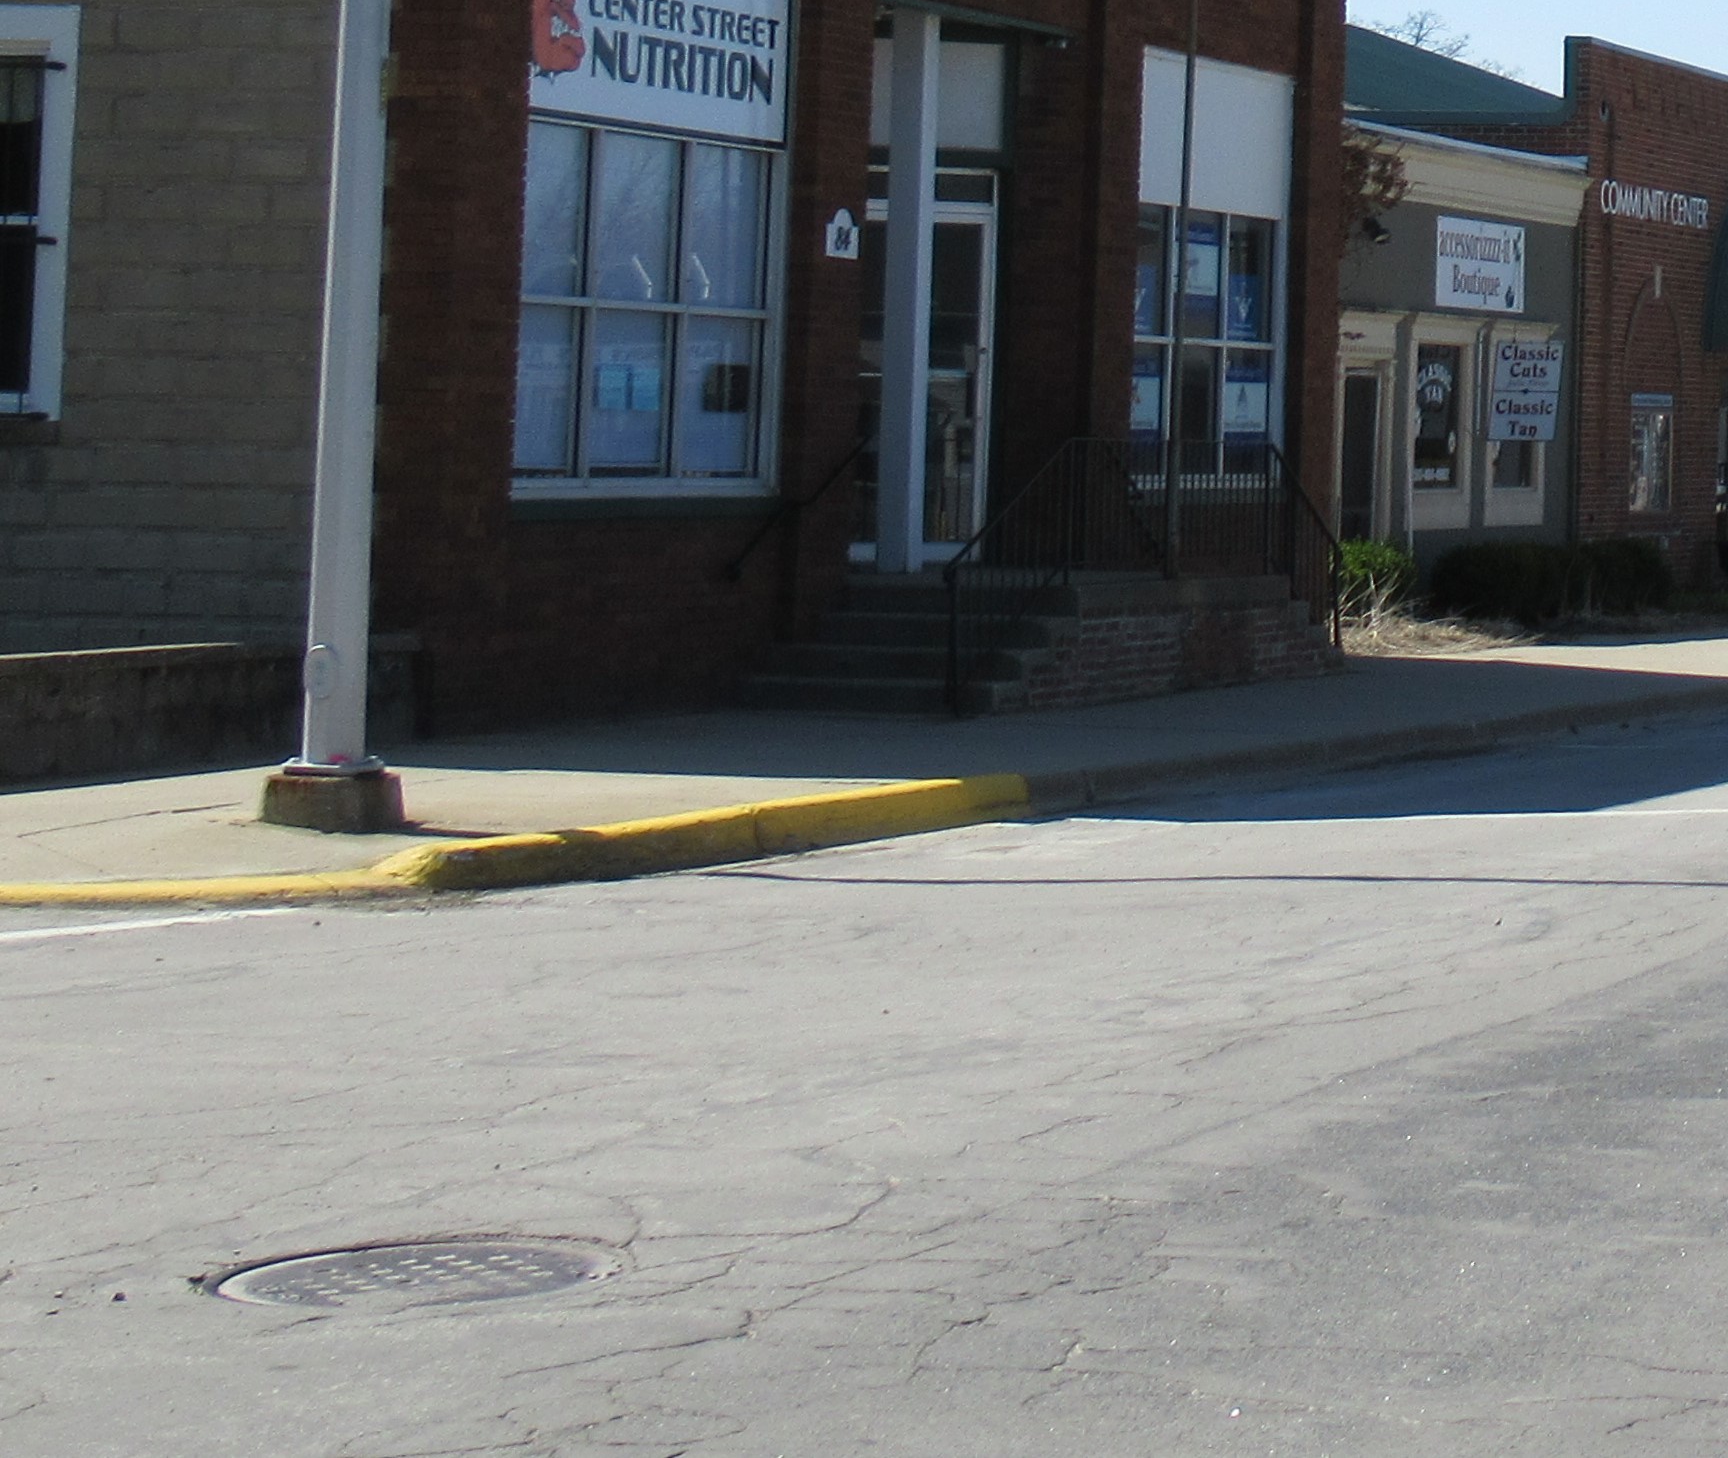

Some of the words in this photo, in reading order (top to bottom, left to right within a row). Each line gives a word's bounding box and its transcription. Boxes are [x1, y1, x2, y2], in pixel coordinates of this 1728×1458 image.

[690, 4, 780, 50] STREET
[591, 26, 774, 106] NUTRITION
[1601, 179, 1670, 223] COMMUNITY
[1671, 192, 1709, 230] CENTER
[1452, 263, 1500, 305] Boutique
[1501, 345, 1560, 361] Classic
[1510, 362, 1548, 378] Cuts
[1495, 399, 1554, 415] Classic
[1508, 420, 1538, 438] Tan
